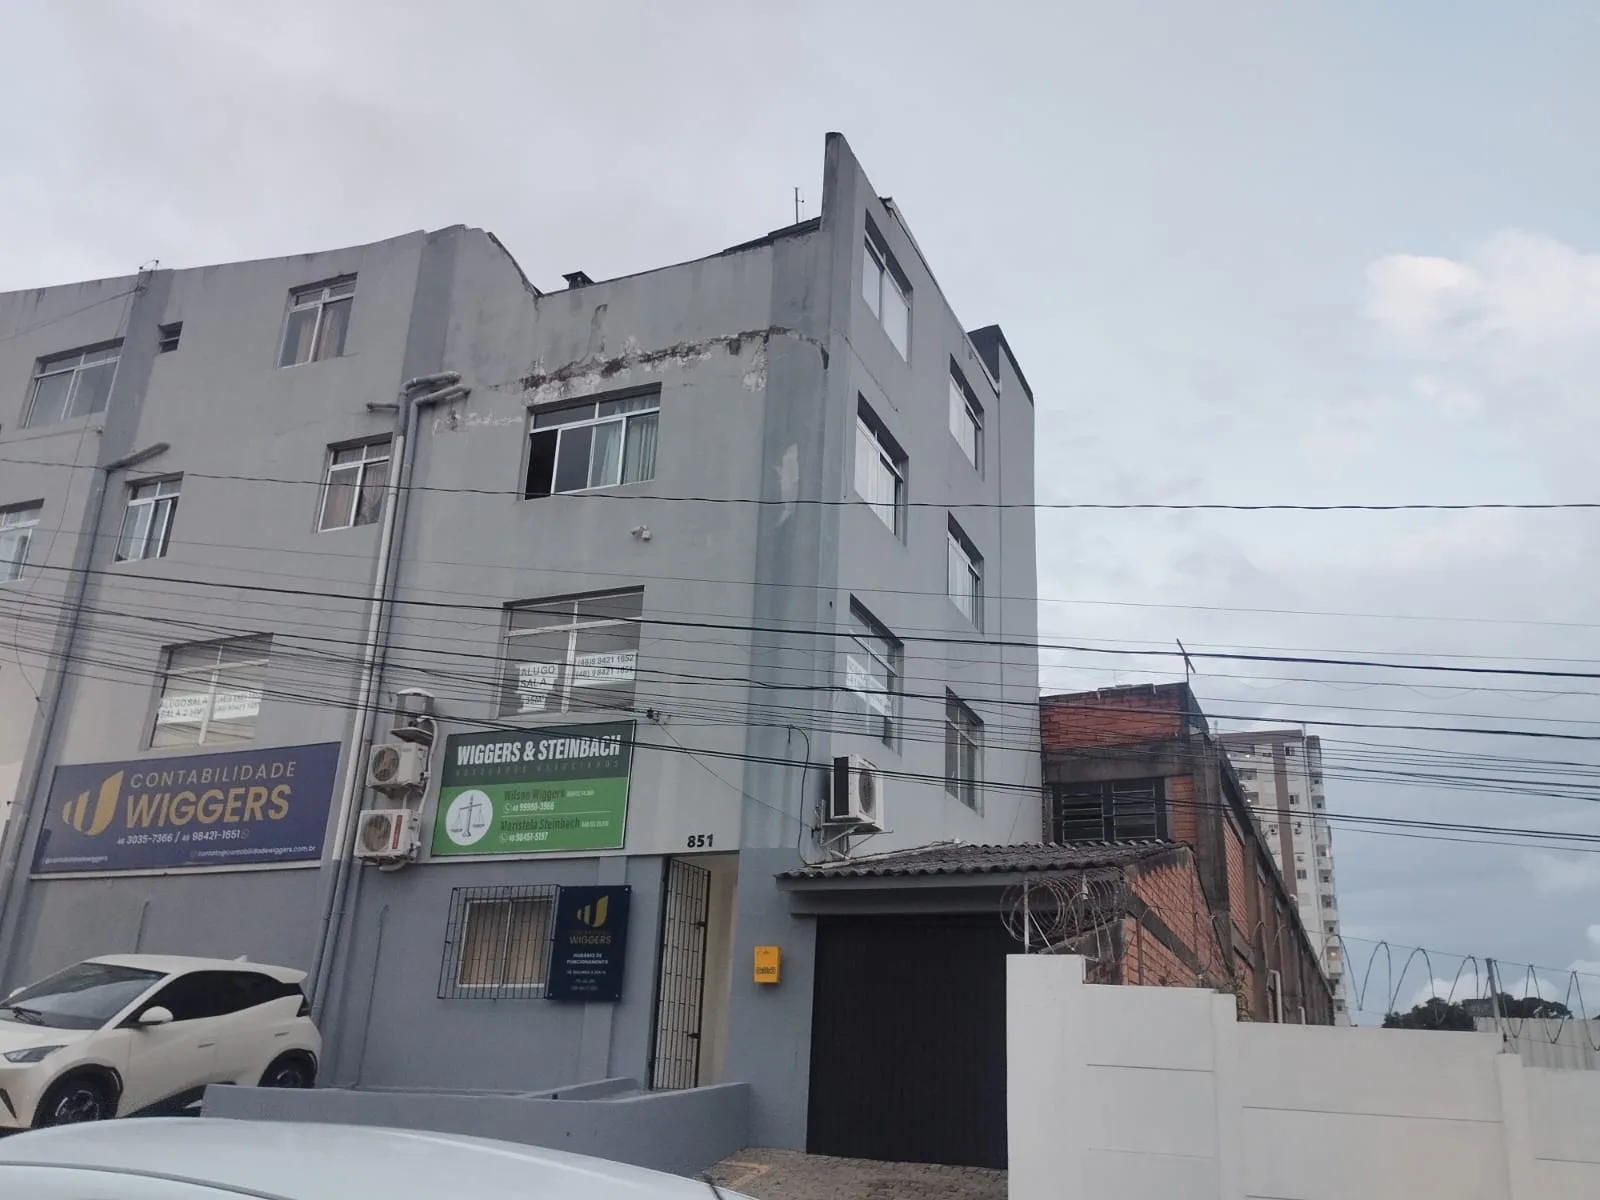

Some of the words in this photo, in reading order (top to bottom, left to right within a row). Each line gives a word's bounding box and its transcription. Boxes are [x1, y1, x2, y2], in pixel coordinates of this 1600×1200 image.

[520, 665, 556, 677] ALUGO
[457, 740, 522, 766] WIGGERS
[523, 741, 536, 762] &
[538, 734, 622, 761] STEINBACH
[130, 761, 296, 788] CONTABILIDADE
[126, 784, 292, 828] WIGGERS
[192, 829, 240, 841] 98421-1651
[687, 834, 714, 848] 851
[570, 936, 612, 946] WIGGERS
